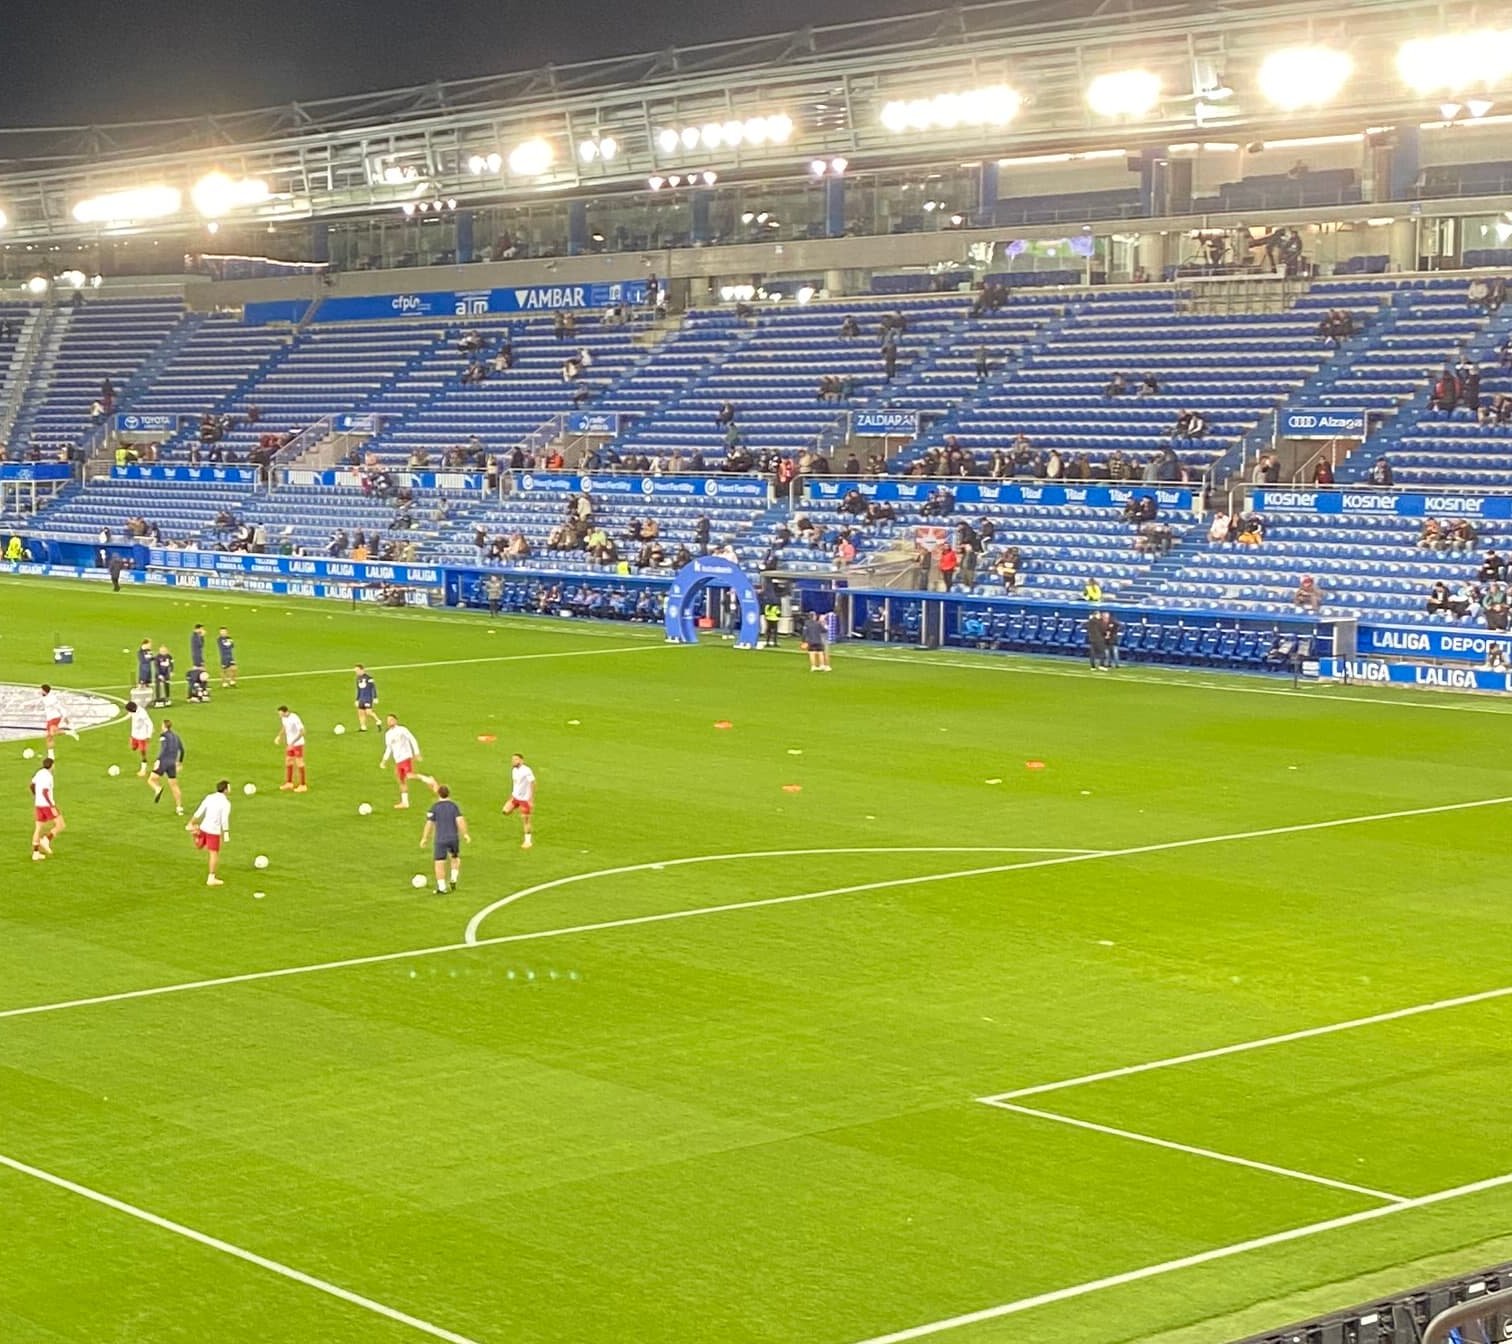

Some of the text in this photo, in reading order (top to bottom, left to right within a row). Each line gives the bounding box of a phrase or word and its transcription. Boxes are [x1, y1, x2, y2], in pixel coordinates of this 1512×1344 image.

[526, 287, 586, 309] AMBAR
[140, 416, 170, 425] TOYOTA
[289, 561, 317, 573] LALIGA
[326, 563, 355, 576] LALIGA
[365, 566, 395, 579] LALIGA
[176, 575, 201, 587] LALIGA
[407, 568, 438, 582] LALIGA
[288, 584, 315, 597] LALIGA
[324, 586, 353, 600] LALIGA
[1372, 631, 1431, 651] LALIGA
[1332, 660, 1478, 689] LALIGA LALIGA
